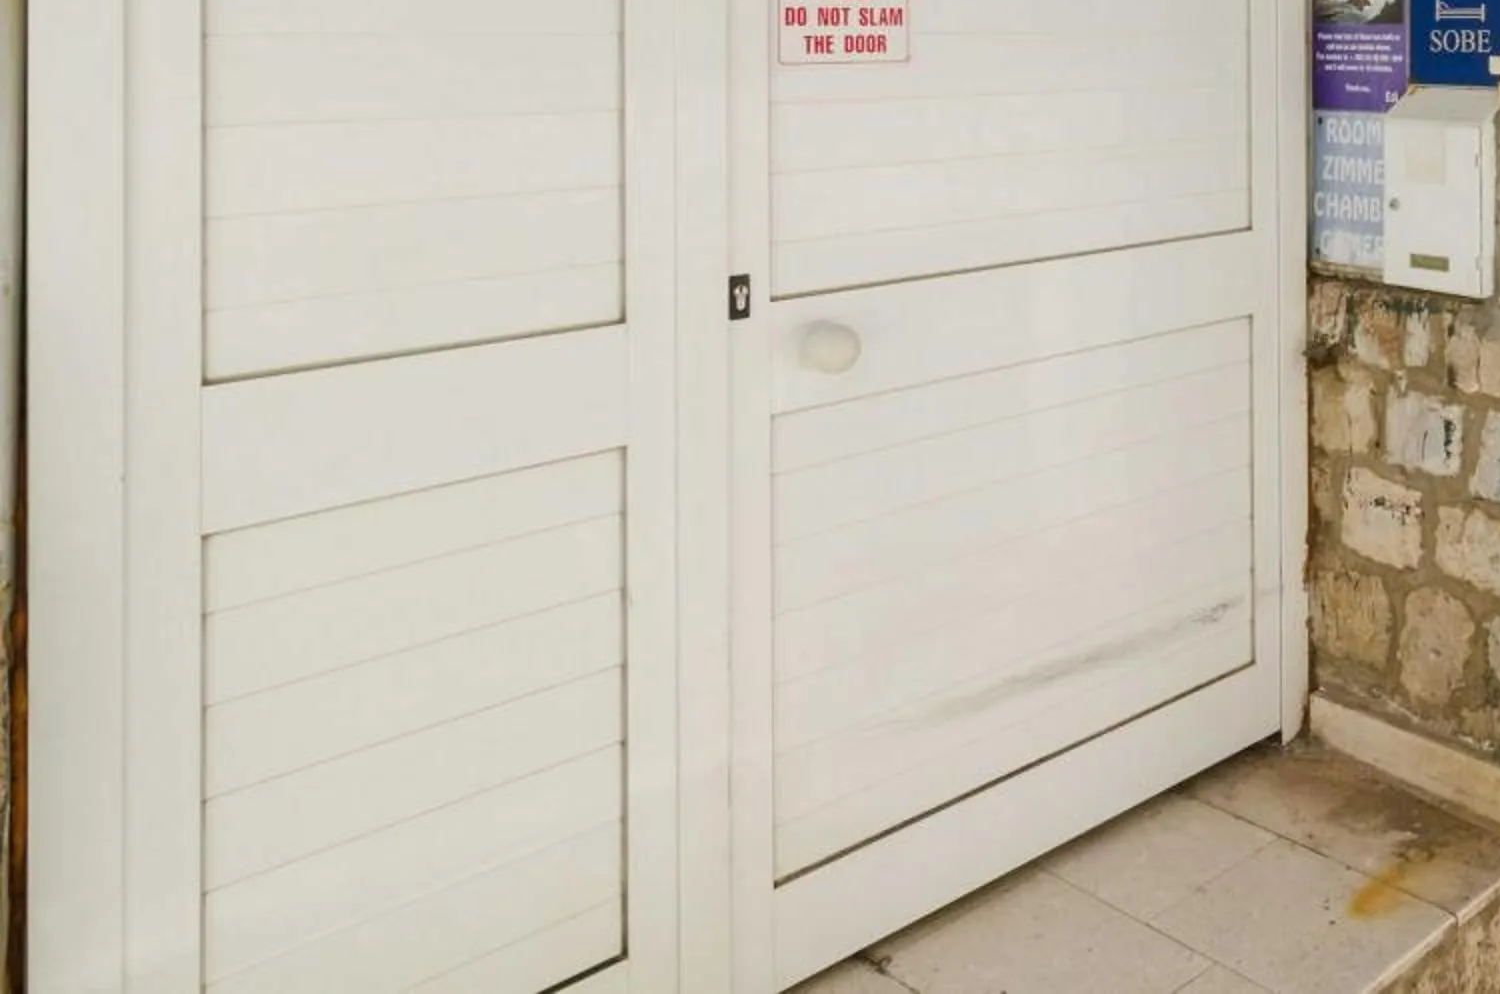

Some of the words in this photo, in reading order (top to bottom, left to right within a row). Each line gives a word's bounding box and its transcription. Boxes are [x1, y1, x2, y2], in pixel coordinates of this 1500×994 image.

[784, 7, 807, 26] DO
[817, 7, 851, 26] NOT
[859, 7, 903, 26] SLAM
[804, 35, 834, 54] THE
[844, 35, 887, 54] DOOR
[1429, 29, 1493, 53] SOBE
